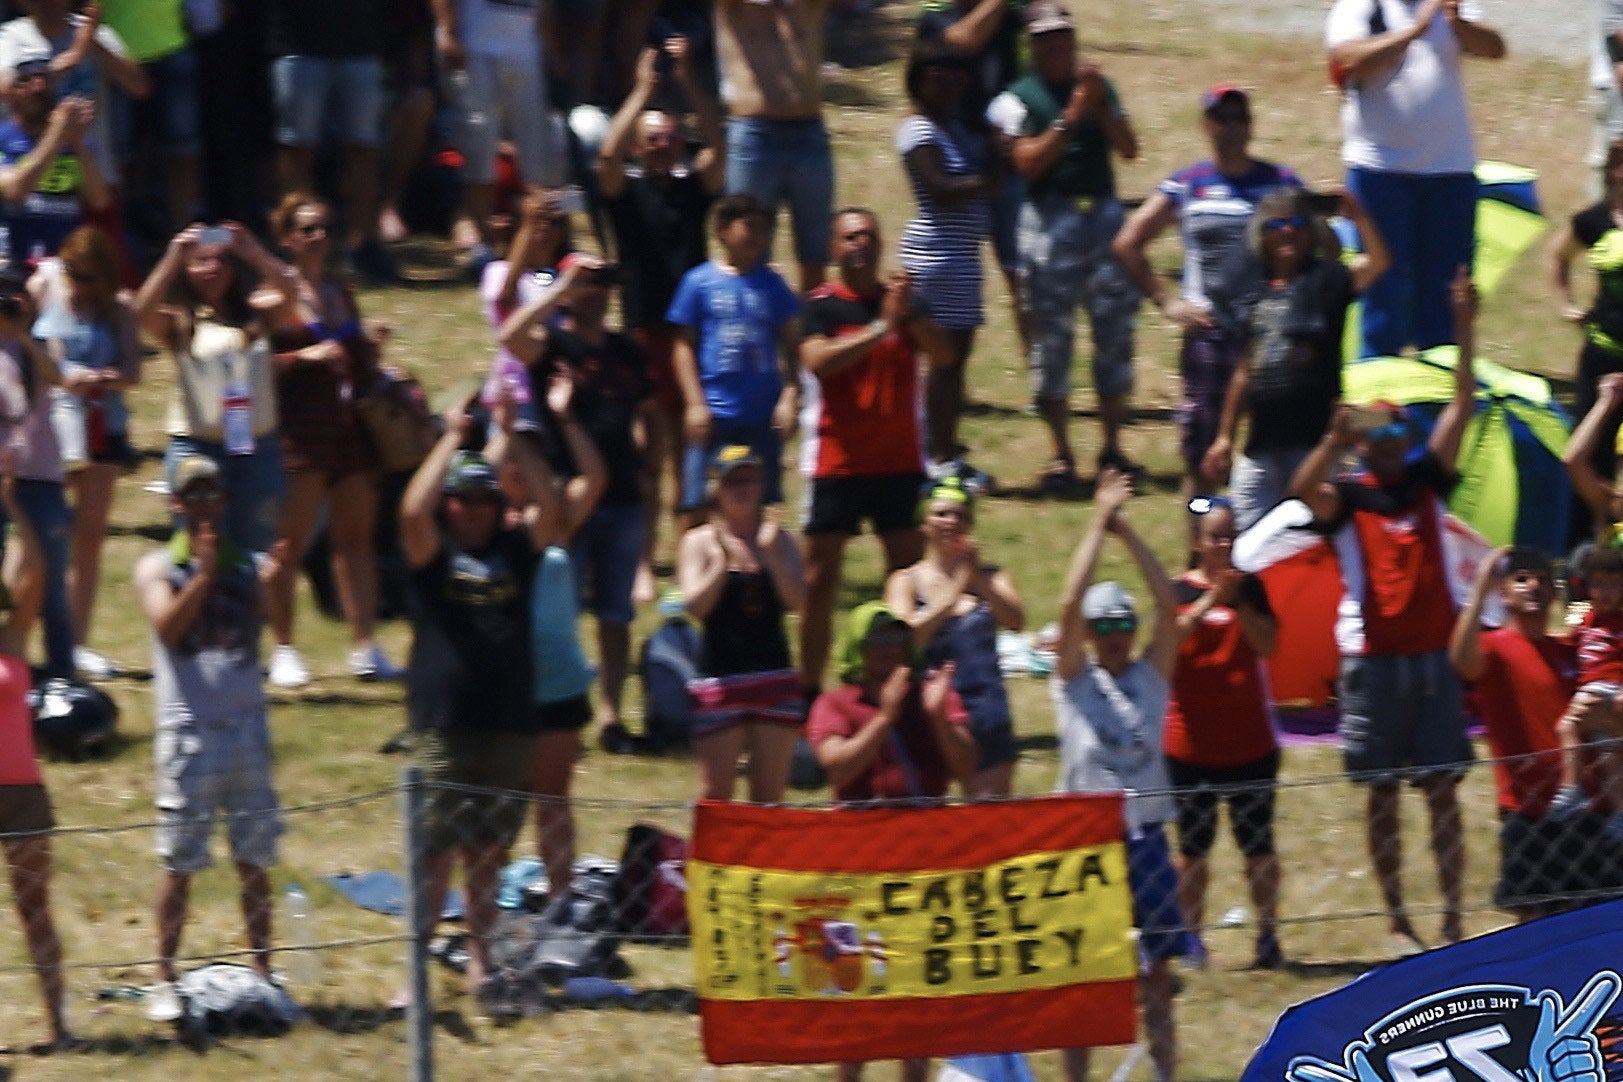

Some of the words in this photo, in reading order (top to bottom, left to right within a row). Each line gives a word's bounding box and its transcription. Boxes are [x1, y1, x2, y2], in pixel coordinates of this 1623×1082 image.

[882, 853, 1110, 916] CABEZA
[931, 906, 1039, 943] DEL
[923, 927, 1084, 985] BUEY
